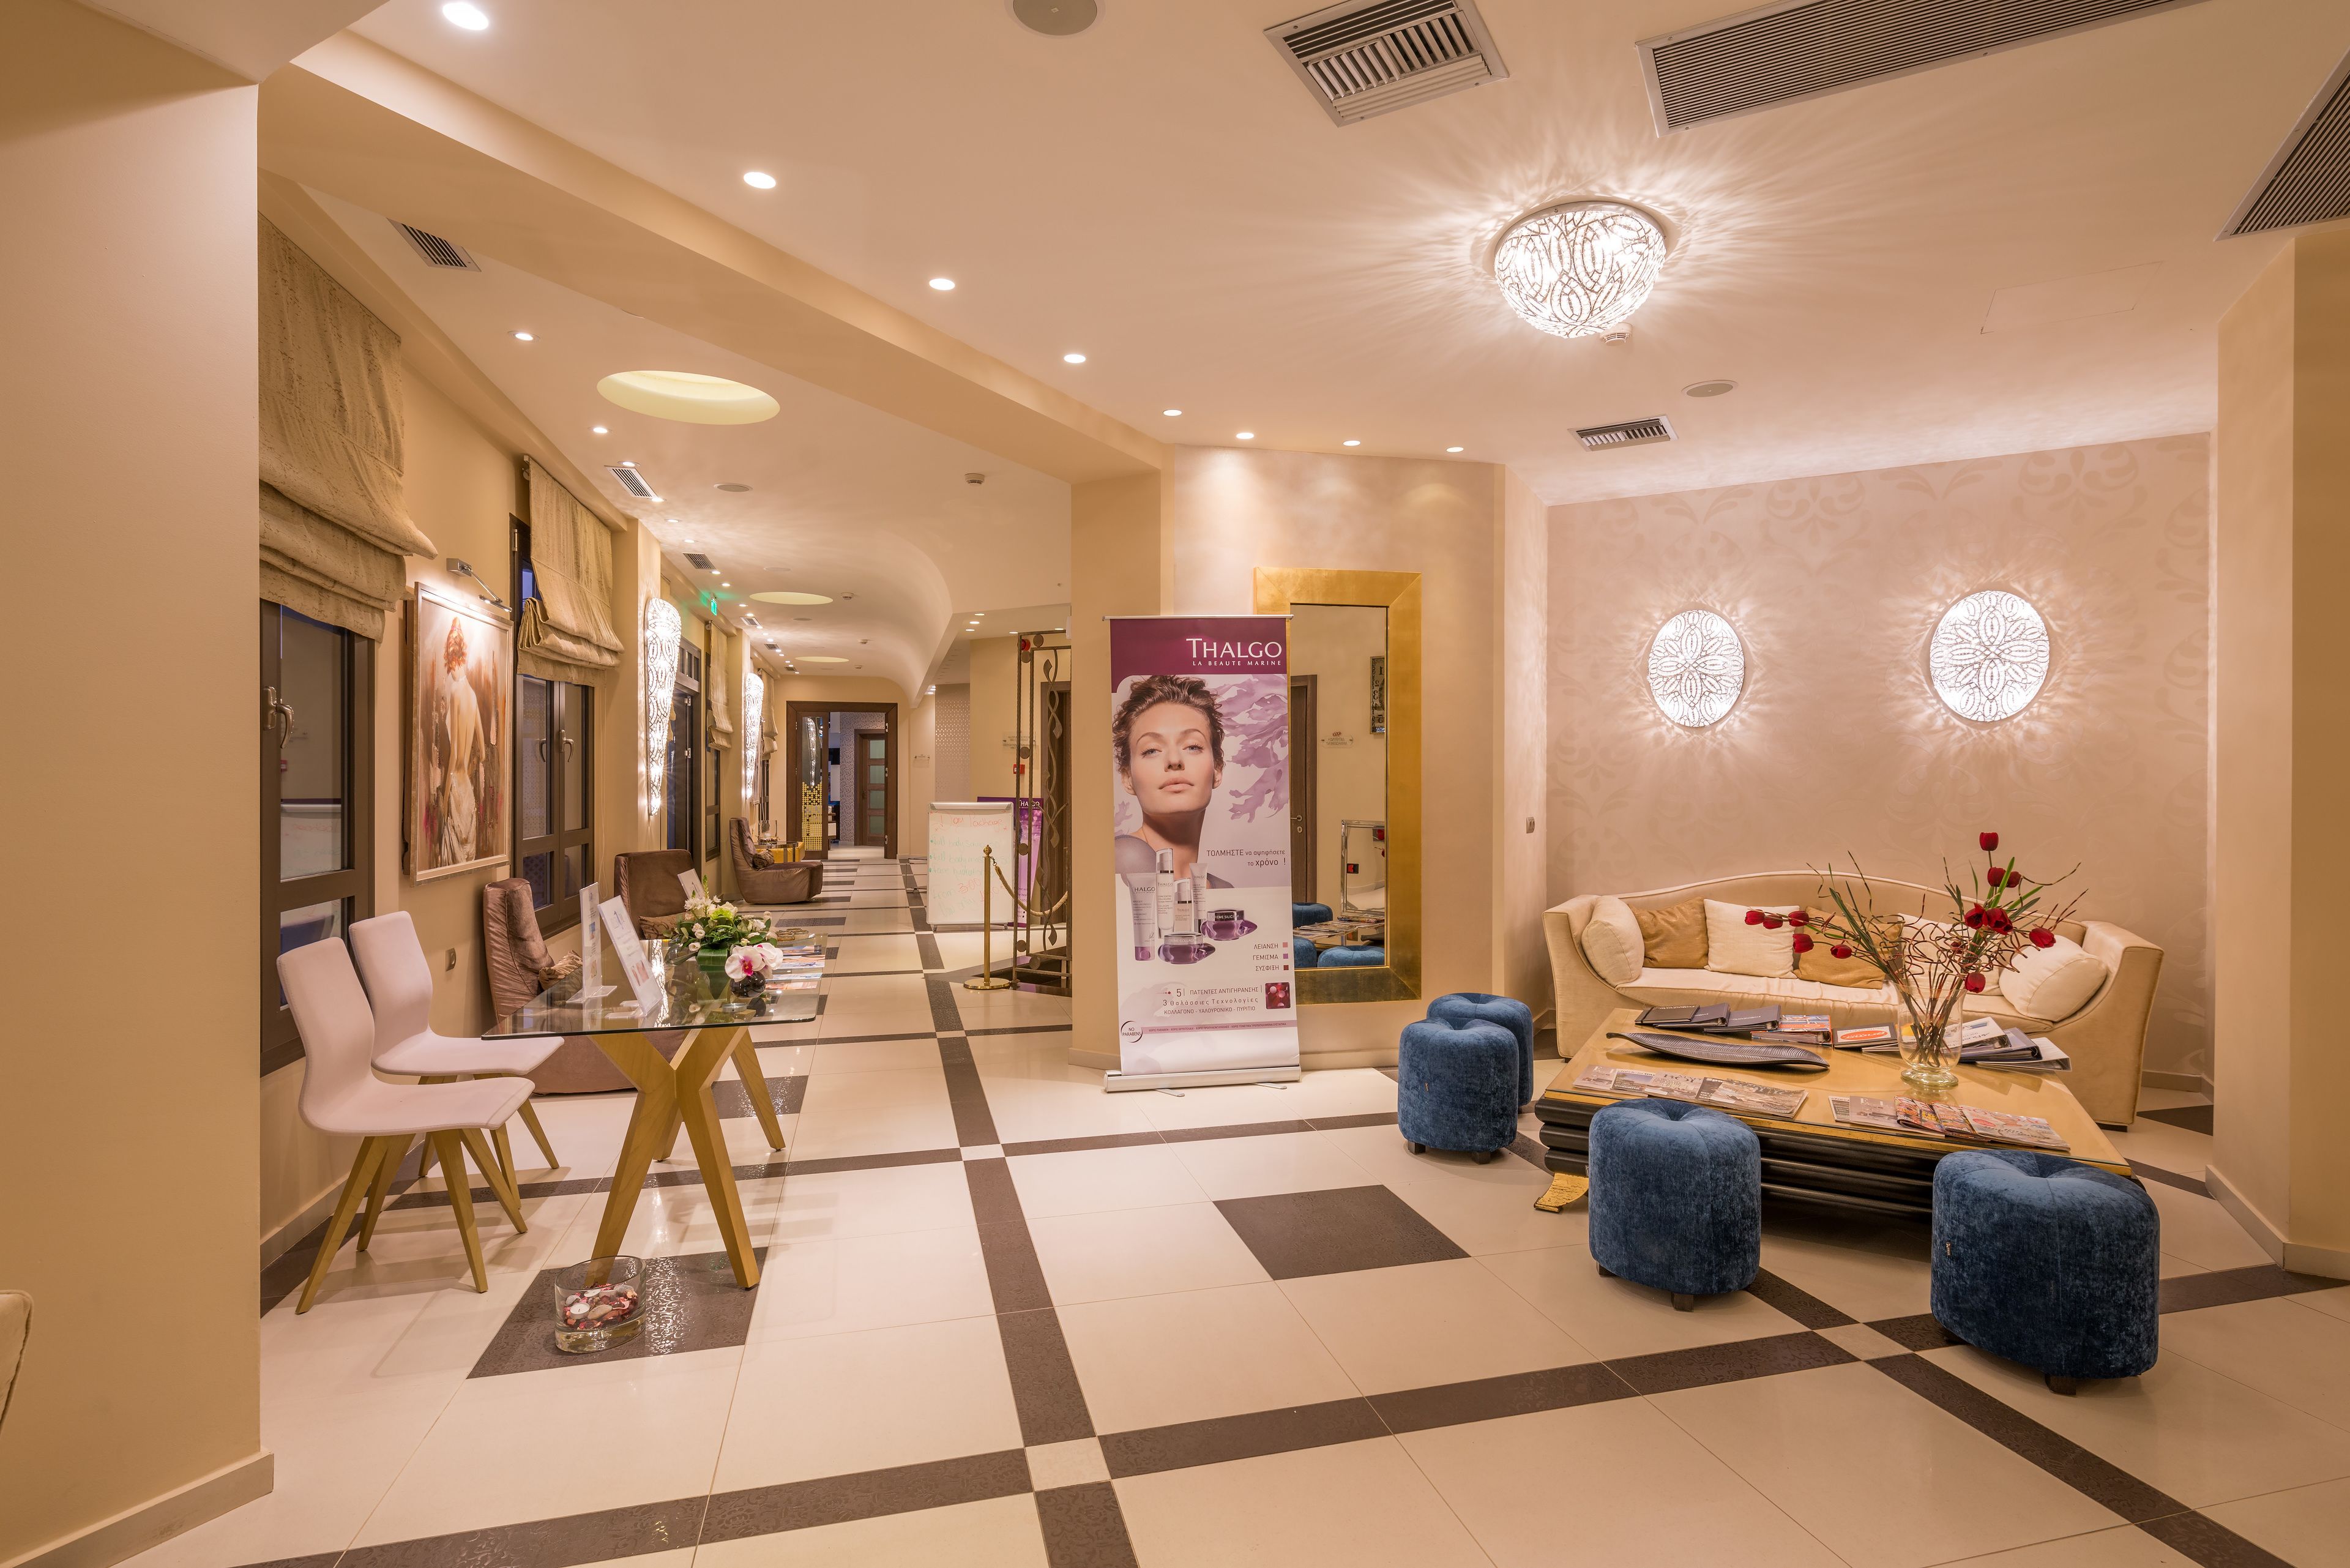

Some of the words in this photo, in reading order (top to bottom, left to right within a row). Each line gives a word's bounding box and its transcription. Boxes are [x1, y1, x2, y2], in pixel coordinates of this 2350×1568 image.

[1186, 638, 1282, 658] THALGO
[1255, 858, 1278, 868] χρόνο
[1176, 988, 1181, 997] 5
